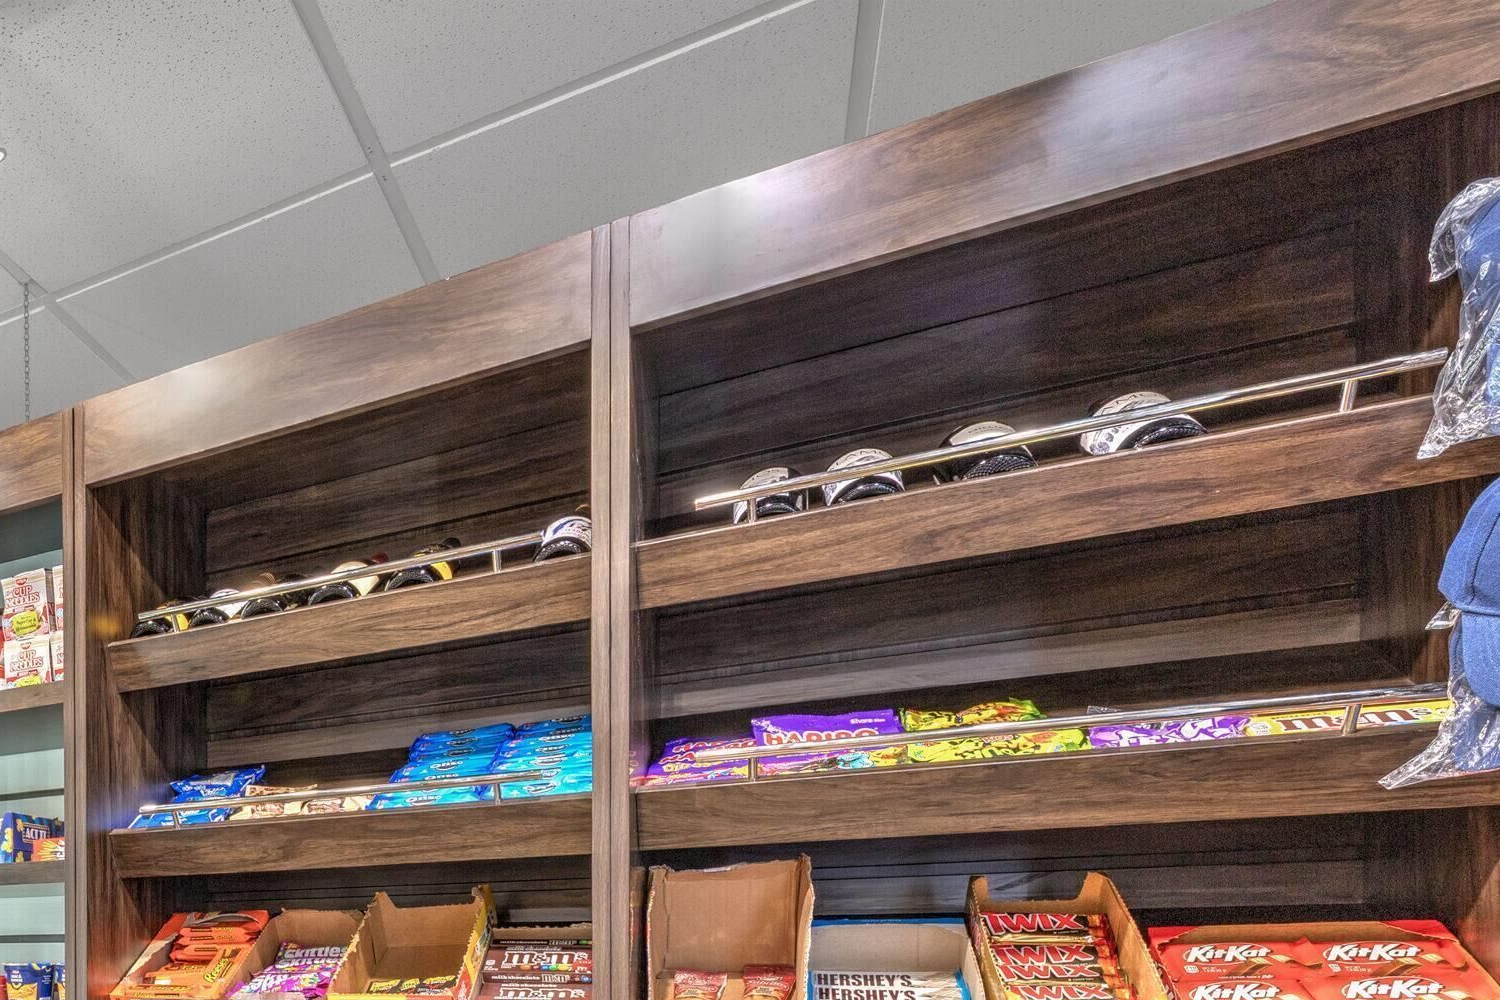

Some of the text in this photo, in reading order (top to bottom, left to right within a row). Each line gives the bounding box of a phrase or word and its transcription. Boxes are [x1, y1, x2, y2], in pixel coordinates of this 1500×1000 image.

[13, 585, 32, 597] CUP
[5, 593, 40, 608] NOODLES
[18, 650, 36, 661] CUP
[10, 657, 43, 672] NOODLES
[982, 913, 1084, 935] TWIX
[992, 944, 1095, 965] TWIX
[816, 974, 912, 987] HERSHEY'S
[996, 965, 1101, 981] TWIX
